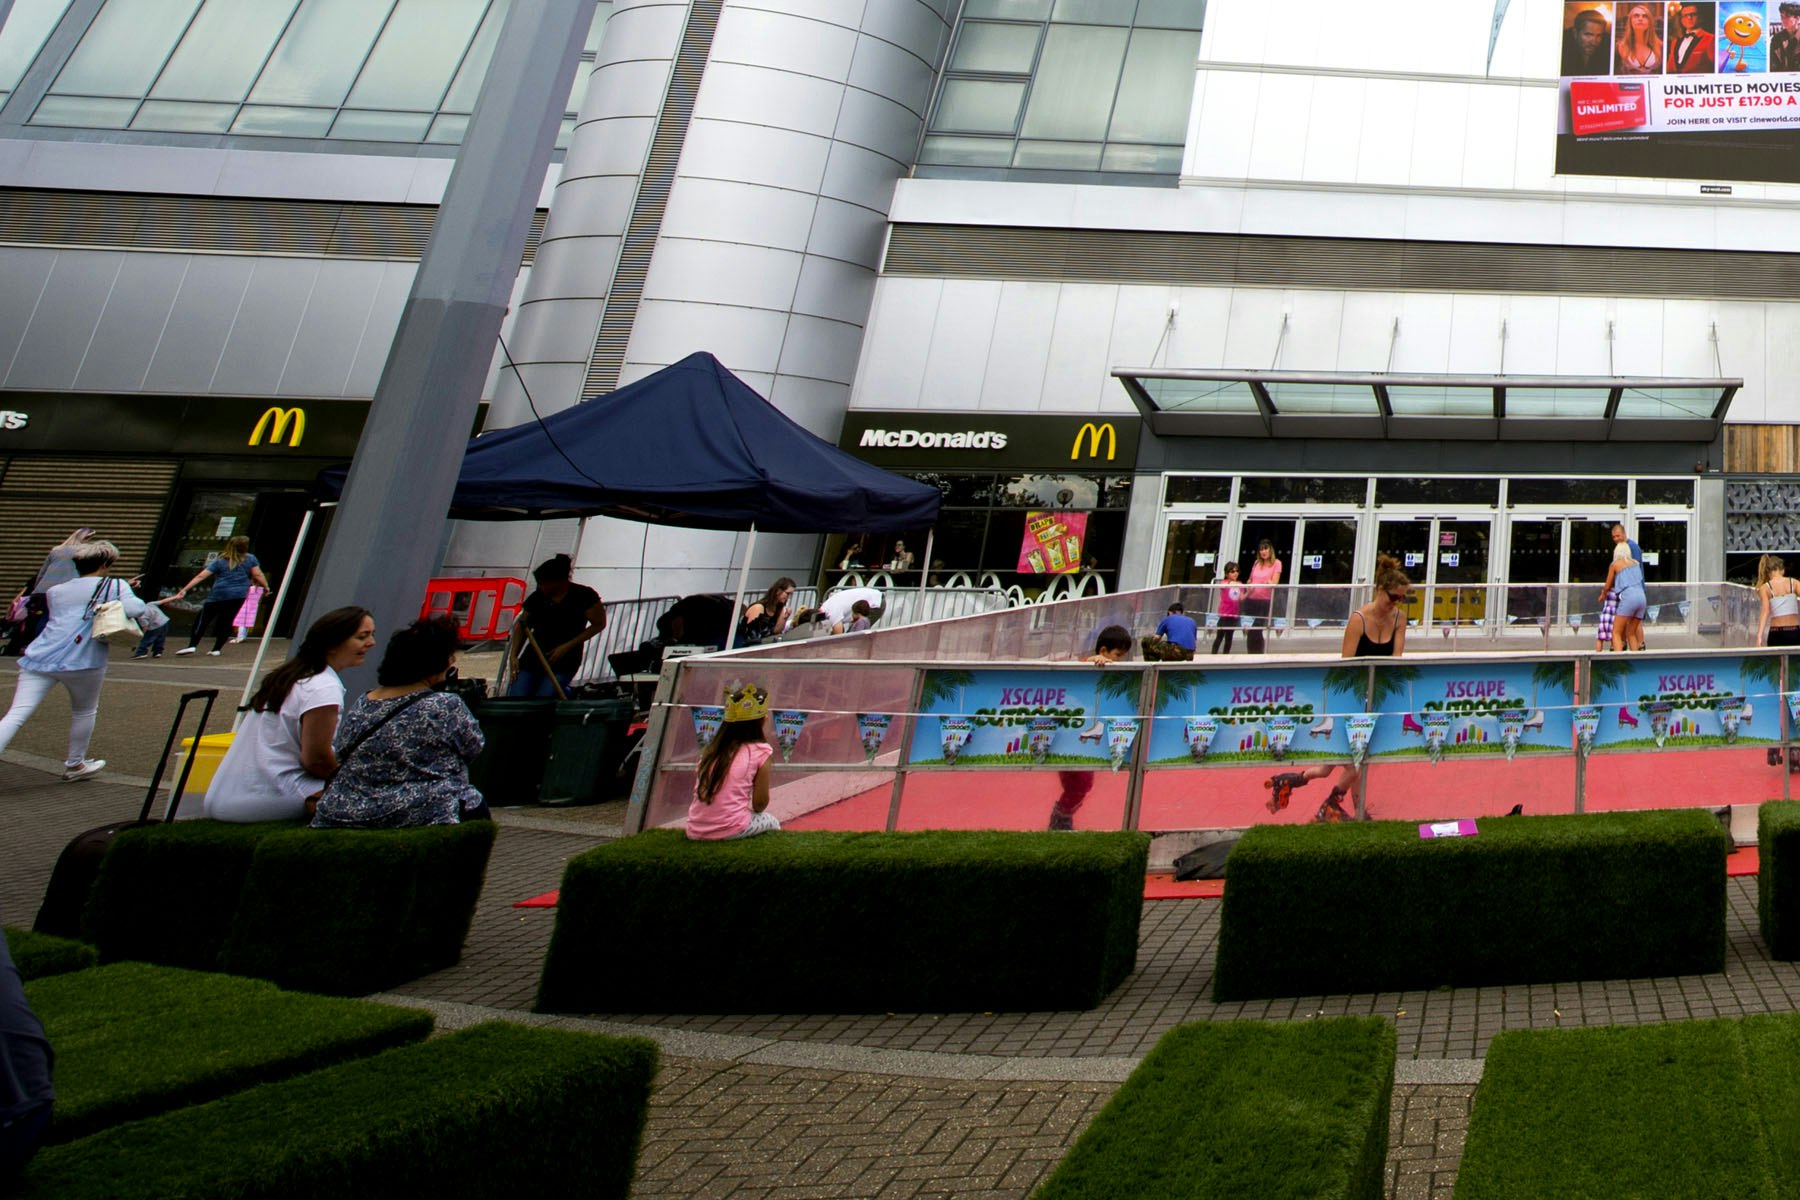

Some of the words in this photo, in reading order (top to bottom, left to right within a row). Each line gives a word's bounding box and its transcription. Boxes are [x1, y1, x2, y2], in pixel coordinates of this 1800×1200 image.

[1664, 84, 1742, 95] UNLIMITED
[1576, 103, 1636, 115] UNLIMITED
[1664, 98, 1694, 108] FOR
[1699, 97, 1734, 108] JUST
[1738, 96, 1782, 106] £17.90
[1787, 95, 1797, 105] A
[860, 429, 1008, 449] McDonald's
[1445, 680, 1506, 698] XSCAPE
[1658, 674, 1715, 692] XSCAPE
[999, 687, 1068, 706] XSCAPE
[1230, 685, 1295, 704] XSCAPE
